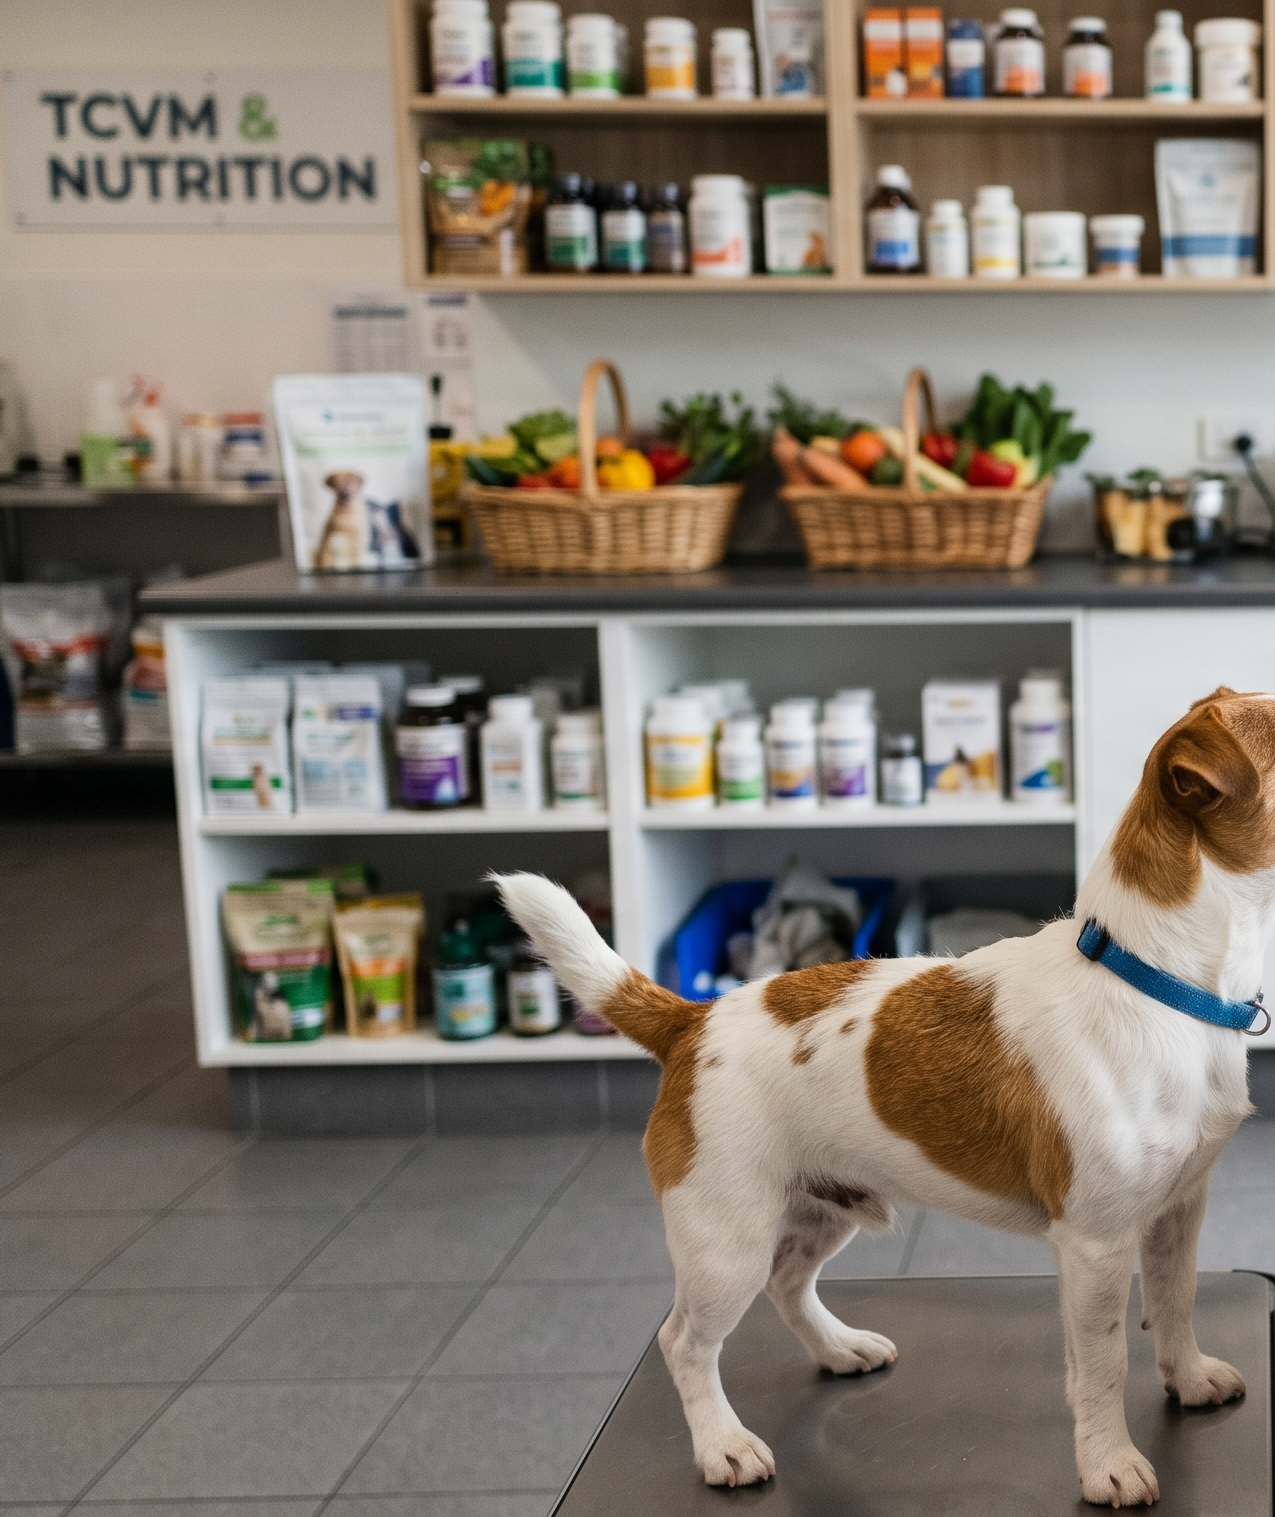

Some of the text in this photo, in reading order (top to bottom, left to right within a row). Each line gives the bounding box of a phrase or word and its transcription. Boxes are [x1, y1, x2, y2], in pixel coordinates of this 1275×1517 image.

[41, 91, 279, 142] TCVM &
[48, 154, 377, 202] NUTRITION
